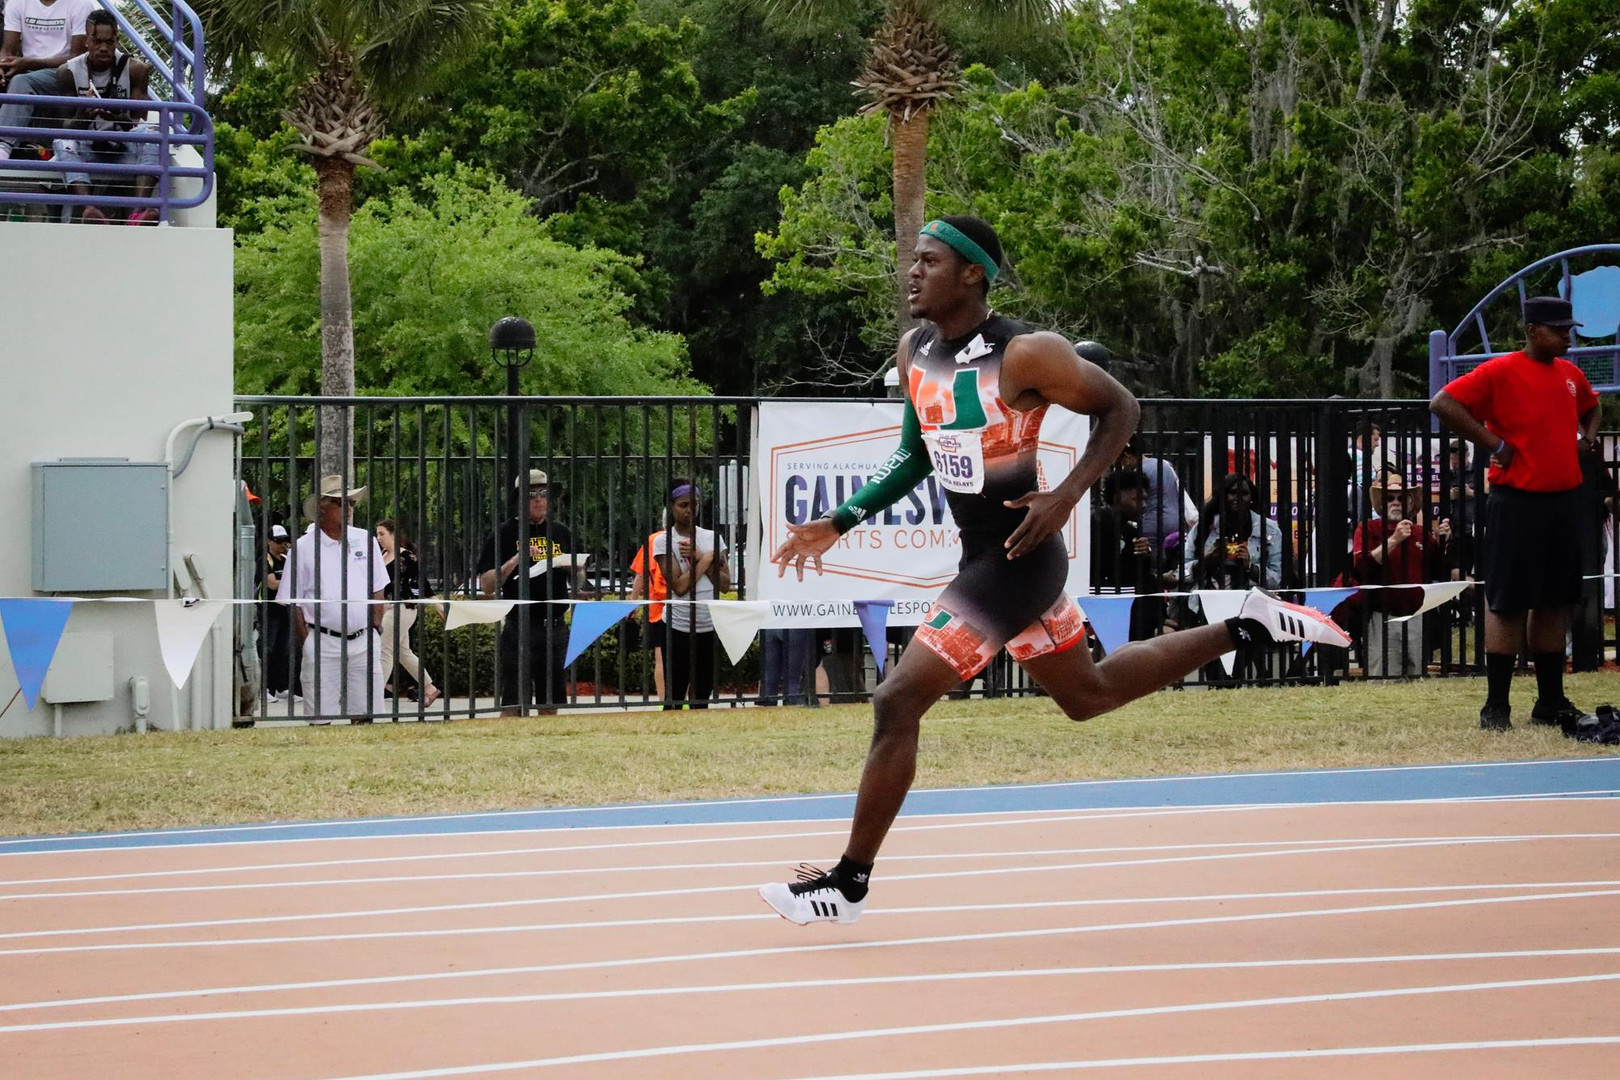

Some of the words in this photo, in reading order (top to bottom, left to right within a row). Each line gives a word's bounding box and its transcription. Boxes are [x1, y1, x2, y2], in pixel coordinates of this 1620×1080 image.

[787, 462, 829, 470] SERVING
[832, 462, 878, 470] ALACHUA
[934, 450, 973, 479] 6159
